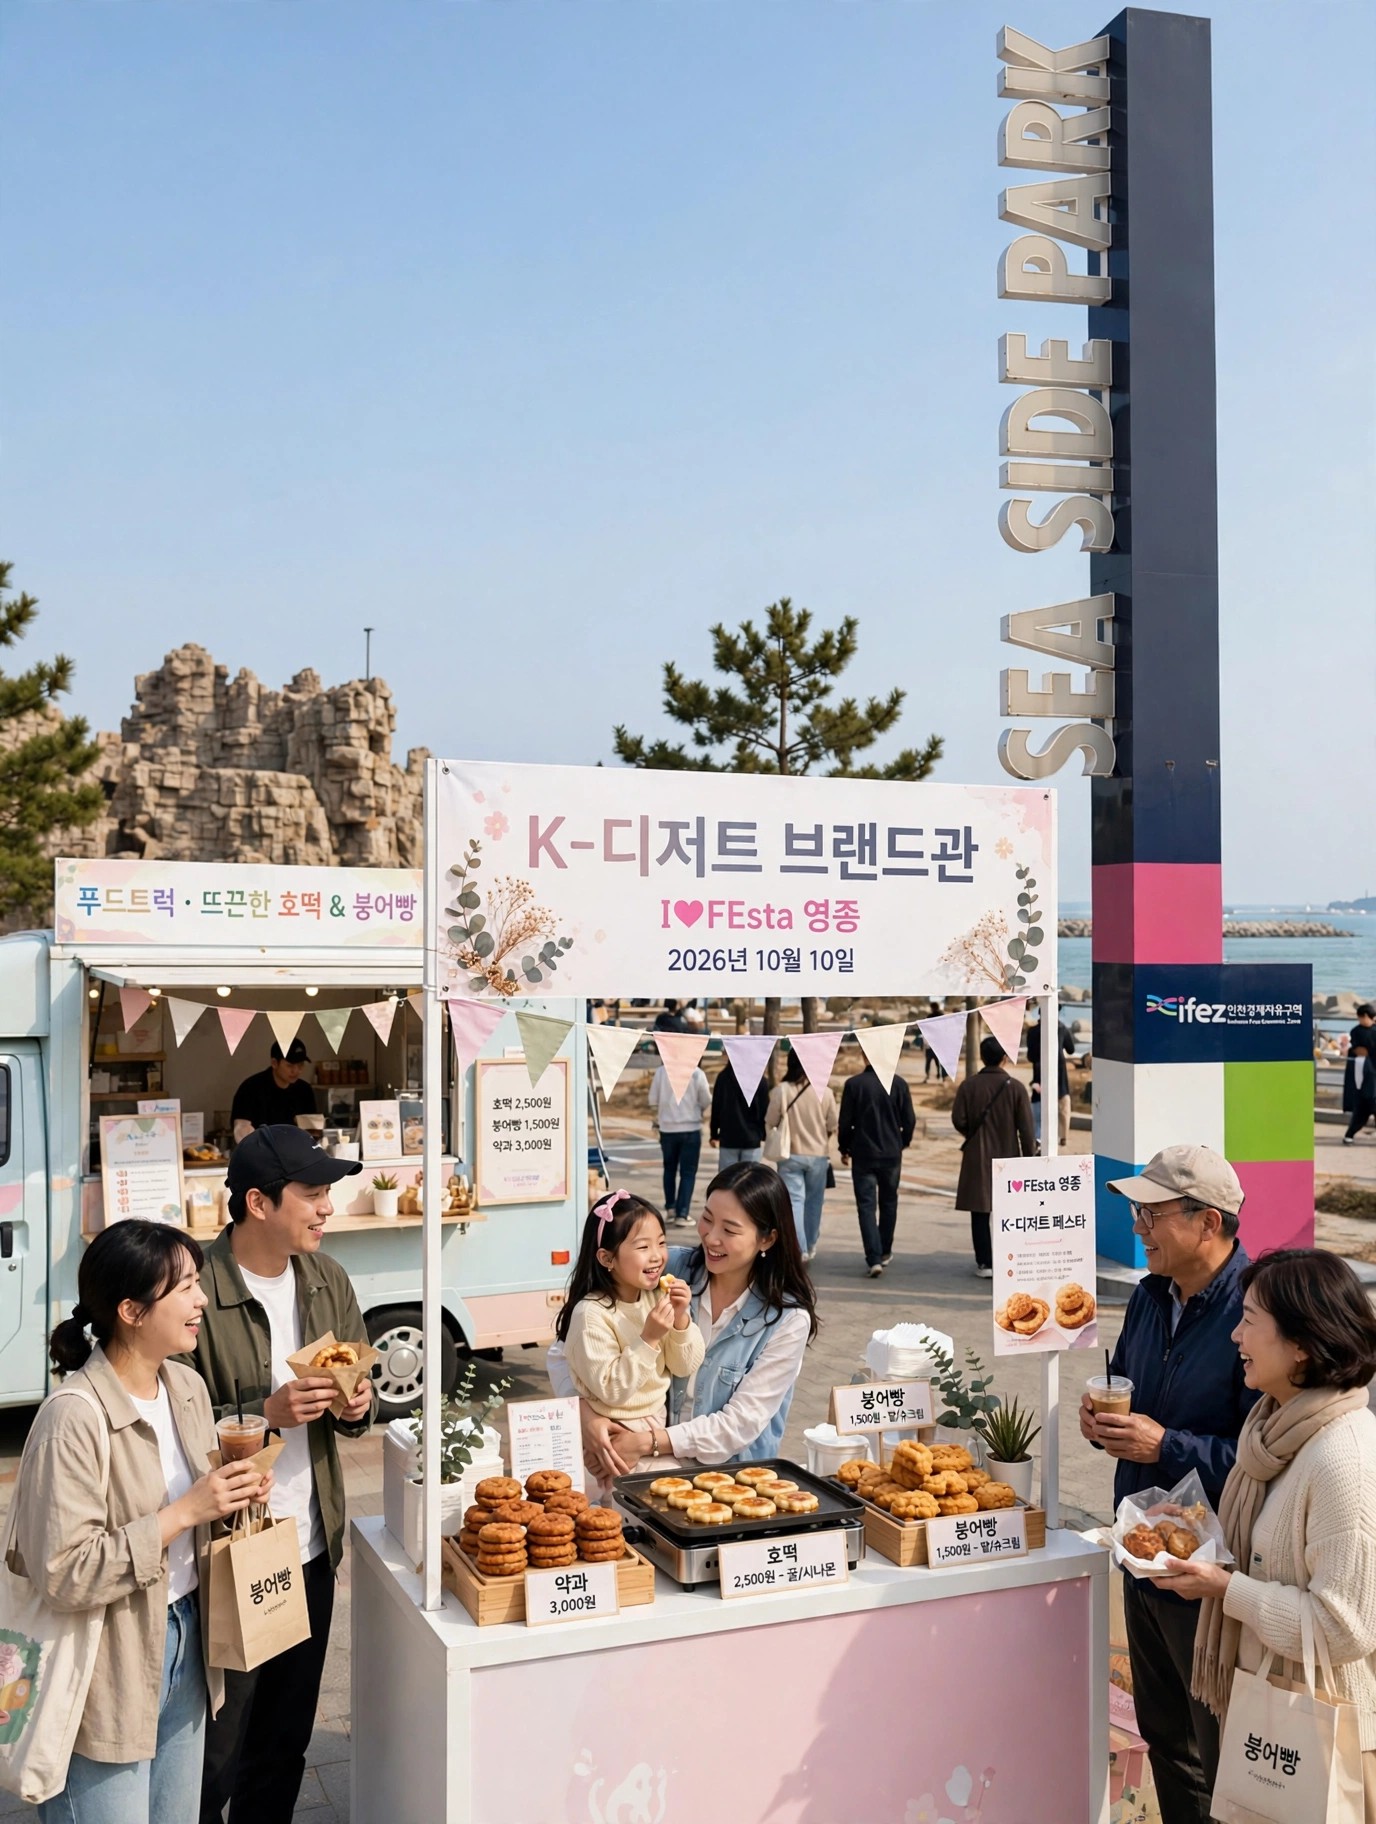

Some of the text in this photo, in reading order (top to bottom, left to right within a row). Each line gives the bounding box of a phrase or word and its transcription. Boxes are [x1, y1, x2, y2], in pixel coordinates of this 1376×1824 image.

[997, 25, 1116, 780] SEA SIDE PARK
[528, 815, 979, 883] K-디저트 브랜드관
[77, 887, 175, 917] 푸드트럭
[200, 890, 271, 918] 뜨끈한
[277, 891, 321, 920] 호떡
[329, 895, 346, 917] &
[353, 893, 417, 922] 붕어빵
[803, 899, 861, 933] 영종
[668, 948, 855, 973] 2026년 10월 10일
[1178, 996, 1226, 1023] ifez
[492, 1097, 552, 1110] 호떡 2,500원
[492, 1118, 560, 1132] 붕어빵 1,500원
[492, 1139, 552, 1152] 약과 3,000원
[1059, 1176, 1081, 1191] 영종
[1002, 1214, 1086, 1232] K-디저트 페스타
[861, 1388, 905, 1410] 붕어빵
[955, 1517, 997, 1540] 붕어빵
[767, 1543, 797, 1564] 호떡
[936, 1543, 971, 1560] 1,500원
[250, 1567, 291, 1605] 붕어빵
[555, 1572, 588, 1594] 약과
[734, 1570, 775, 1588] 2,500원
[550, 1595, 596, 1615] 3,000원
[1244, 1733, 1301, 1776] 붕어빵
